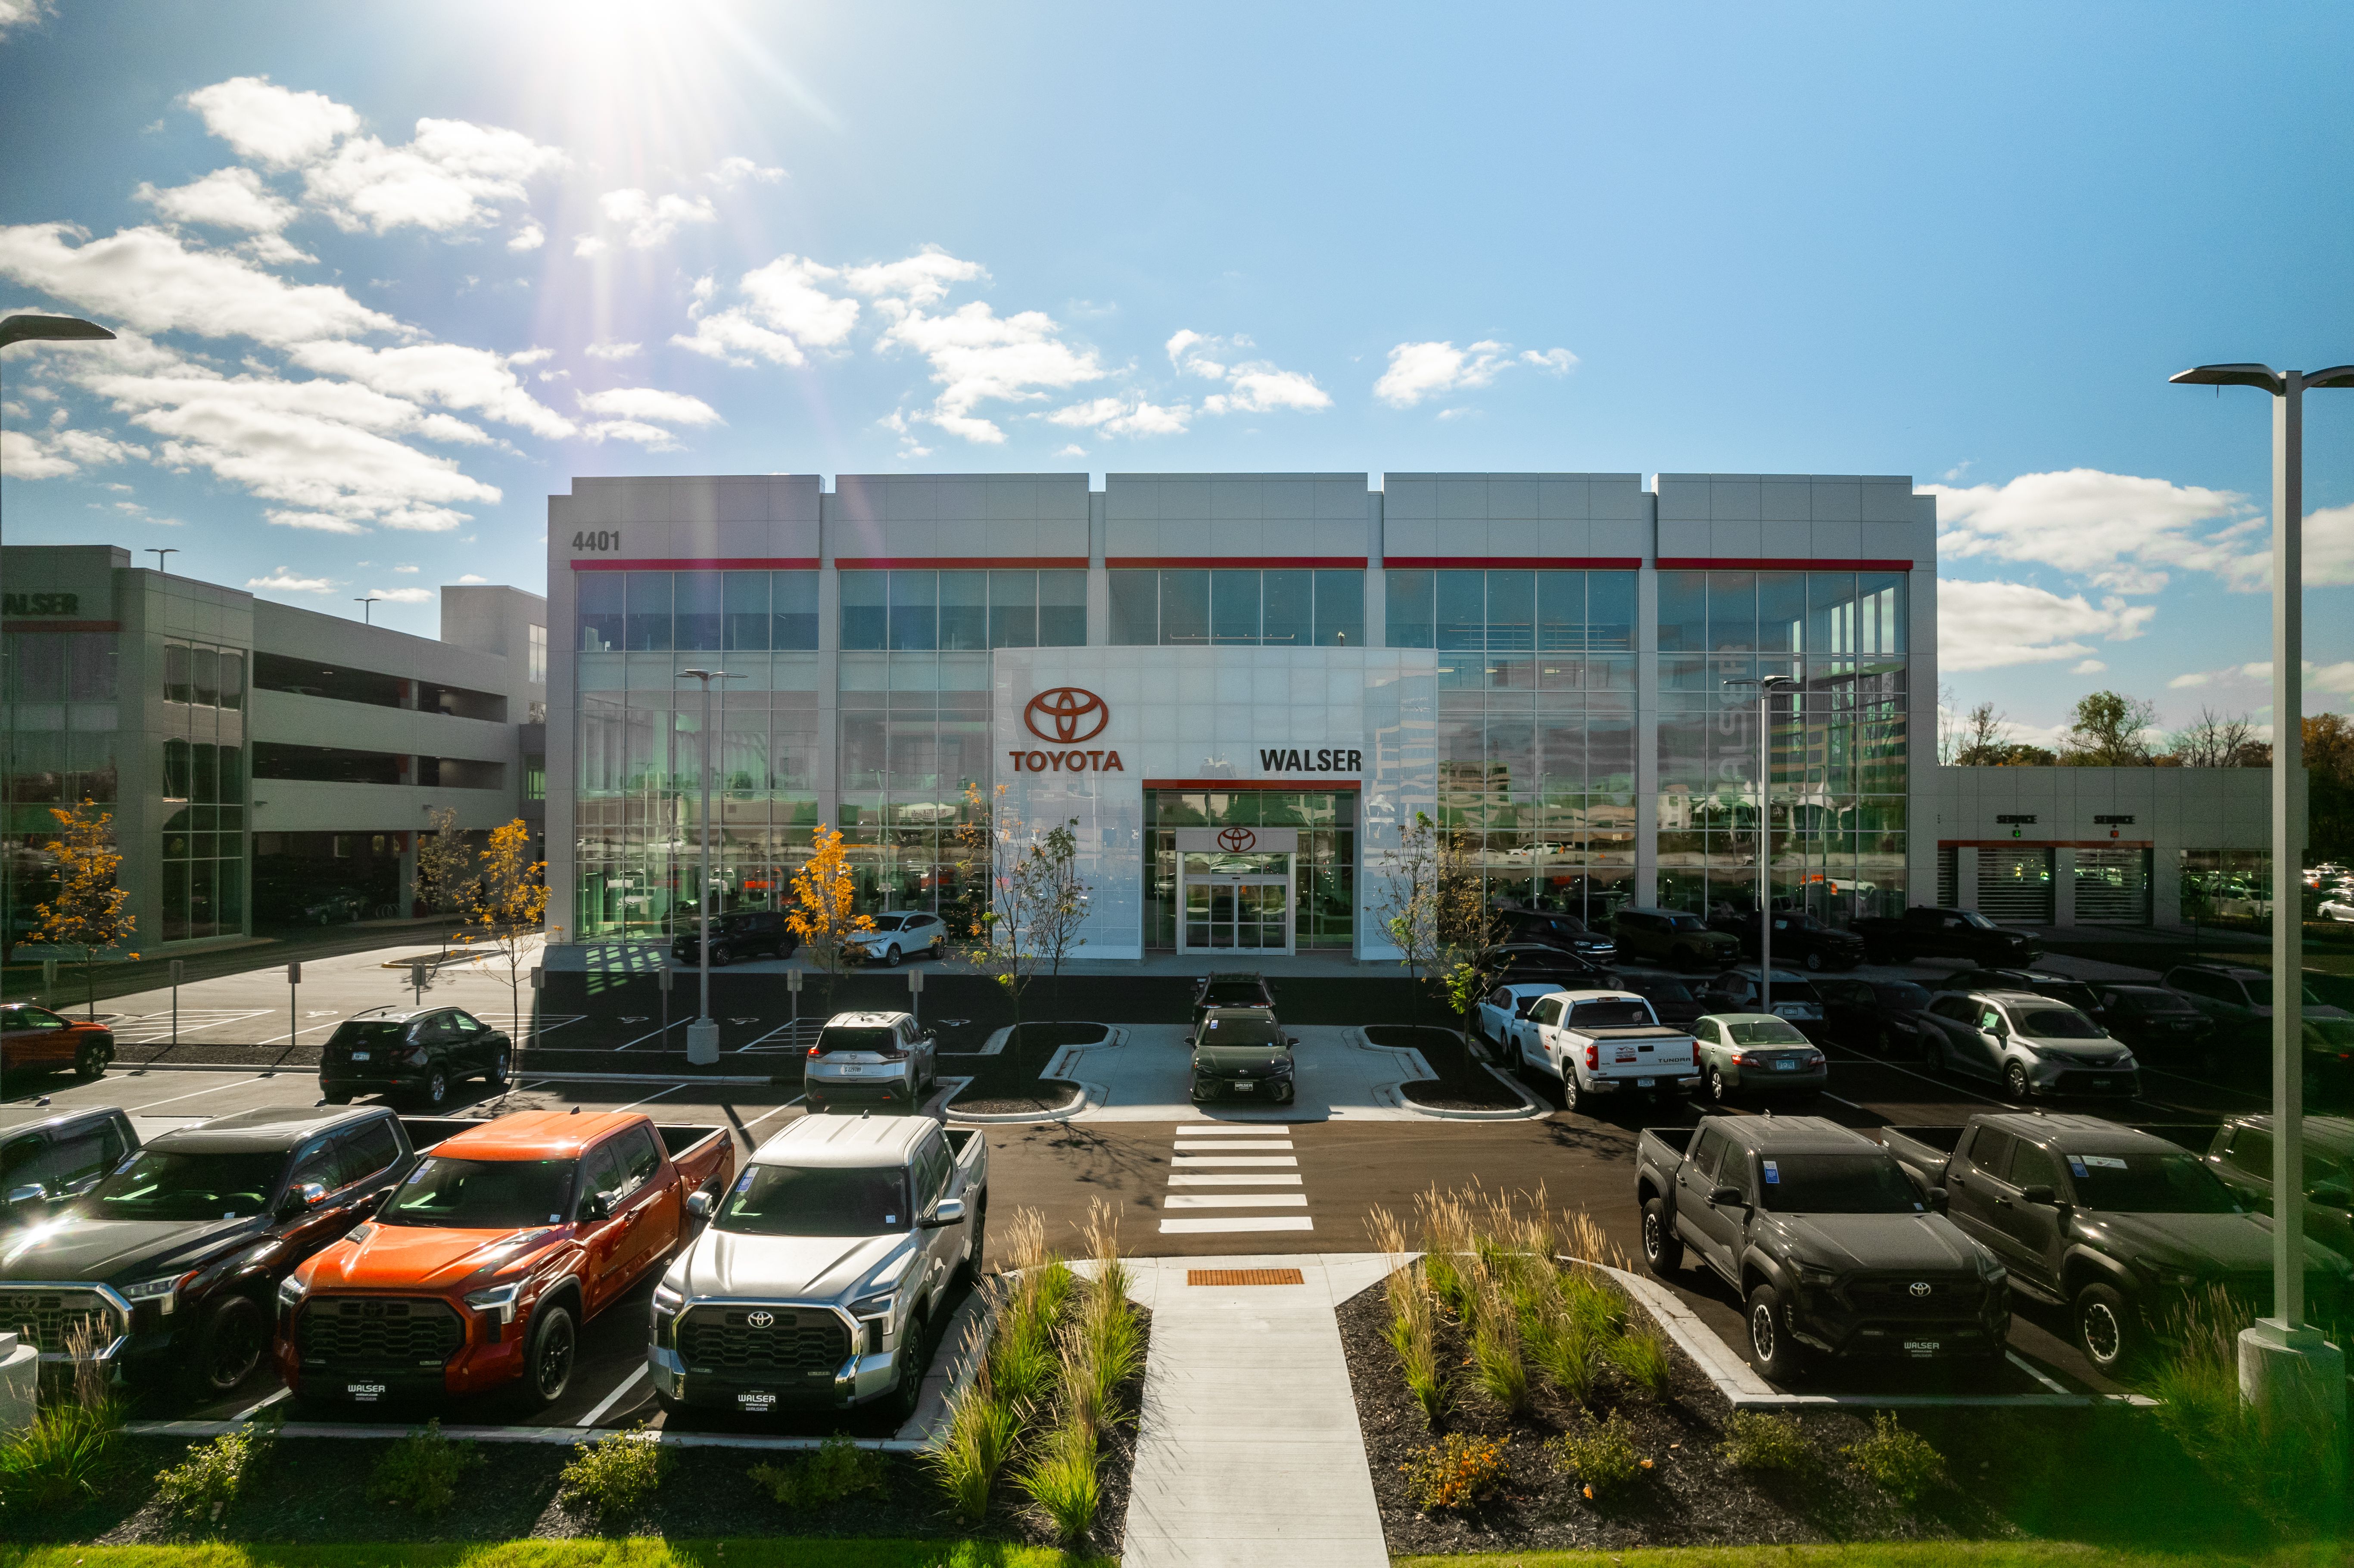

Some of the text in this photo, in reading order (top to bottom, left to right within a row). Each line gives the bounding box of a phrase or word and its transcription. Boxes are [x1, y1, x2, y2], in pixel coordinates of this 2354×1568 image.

[572, 531, 619, 551] 4401
[2, 593, 78, 615] ALSER
[1719, 645, 1747, 782] ALSER
[1009, 750, 1124, 772] TOYOTA
[1260, 749, 1361, 772] WALSER
[738, 1394, 775, 1403] WALSER
